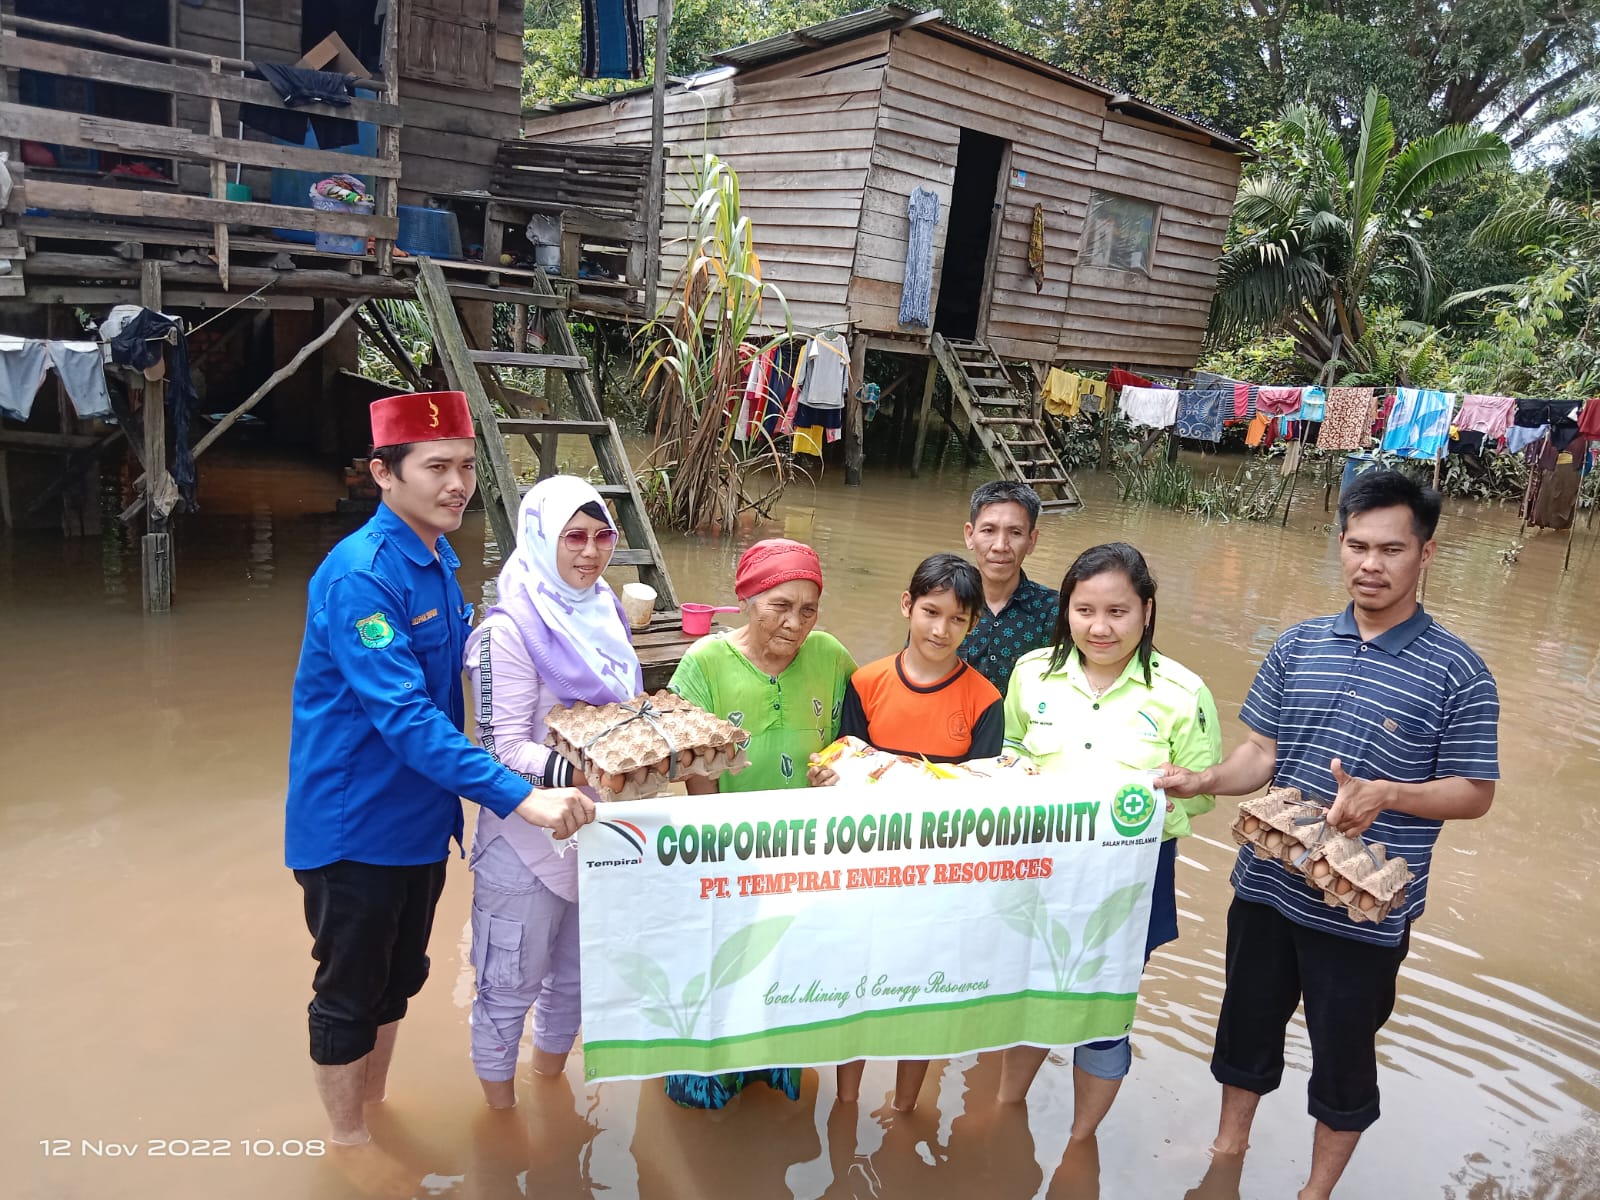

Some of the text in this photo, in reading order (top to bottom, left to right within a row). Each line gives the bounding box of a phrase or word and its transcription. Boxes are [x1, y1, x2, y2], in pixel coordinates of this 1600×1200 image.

[656, 801, 1101, 866] CORPORATE SOCIAL RESPONSIBILITY
[586, 856, 643, 869] Tempirai
[699, 857, 1053, 900] PT. TEMPIRAI ENERGY RESOURCES
[763, 971, 991, 1009] Coal Mining & Energy Resources
